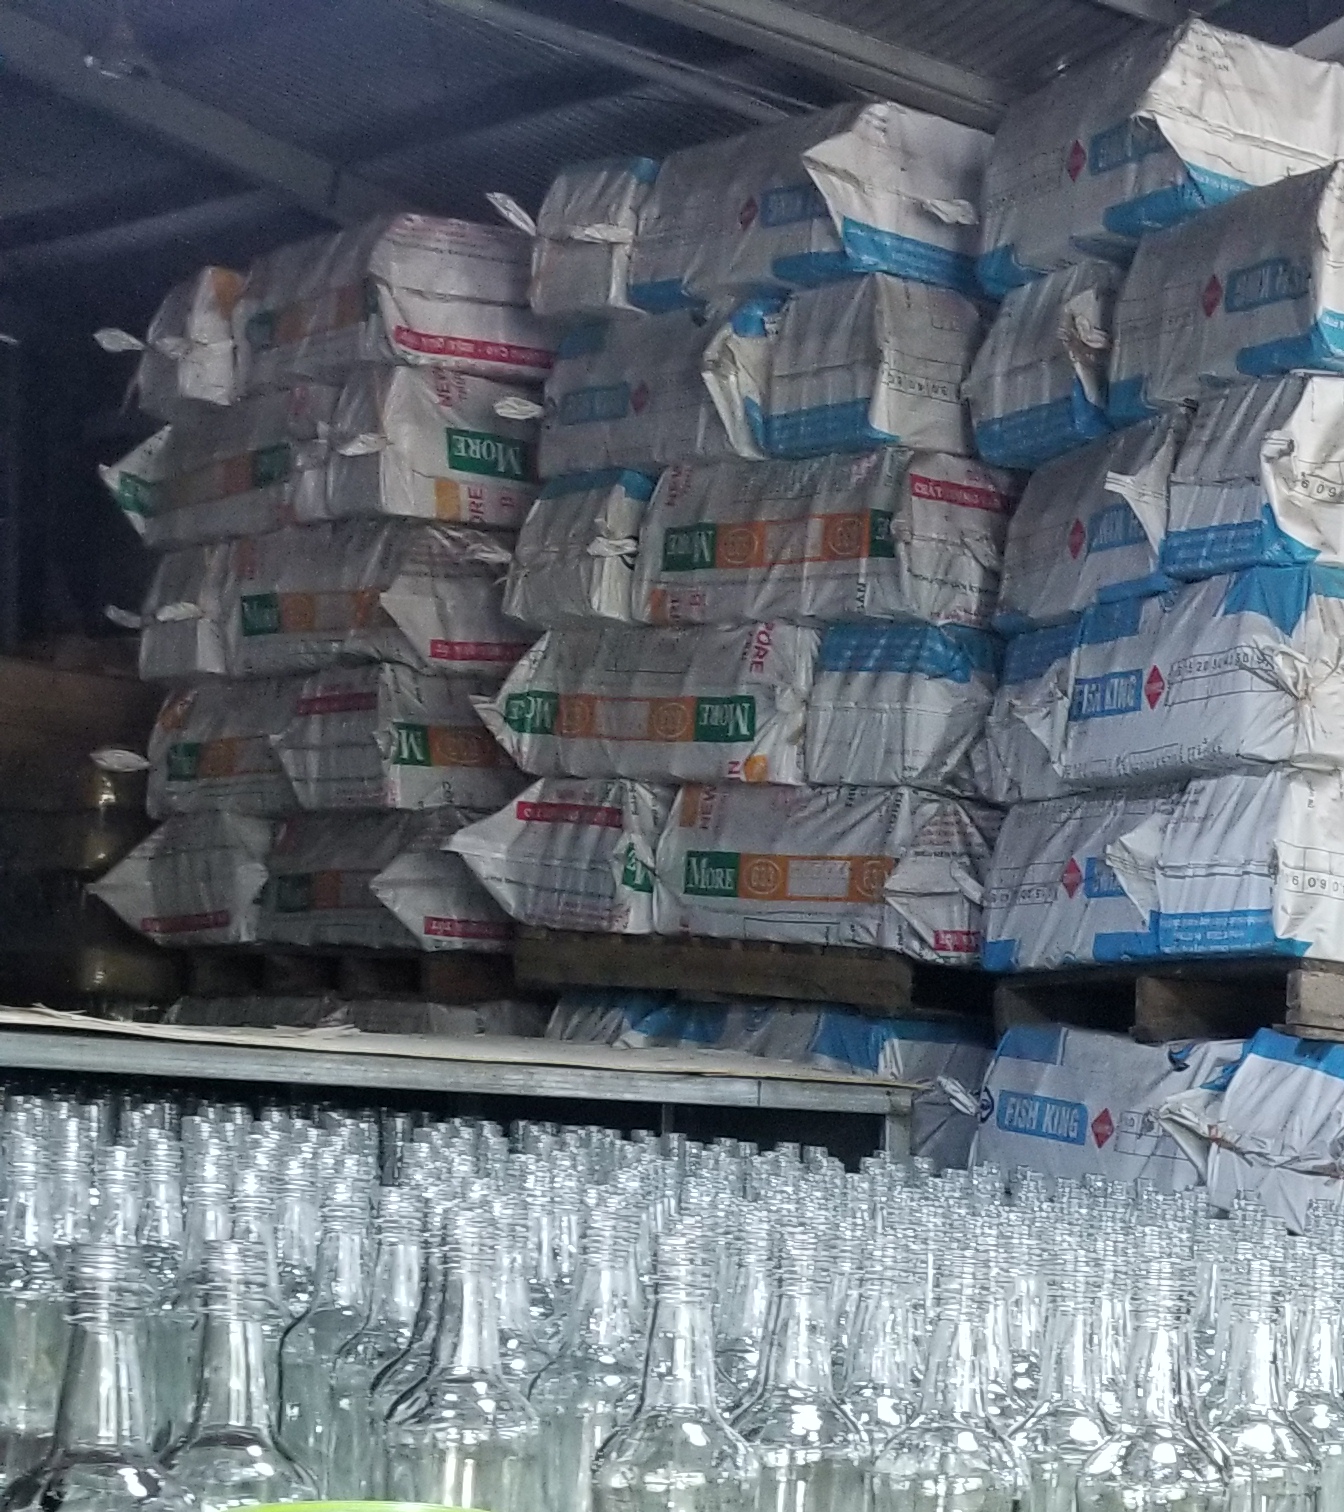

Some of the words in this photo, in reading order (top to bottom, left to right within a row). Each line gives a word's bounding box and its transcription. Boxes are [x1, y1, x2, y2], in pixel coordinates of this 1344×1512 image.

[452, 435, 522, 475] MORE
[687, 856, 735, 891] MORE
[1004, 1098, 1041, 1132] FISH
[1042, 1104, 1080, 1139] KING
